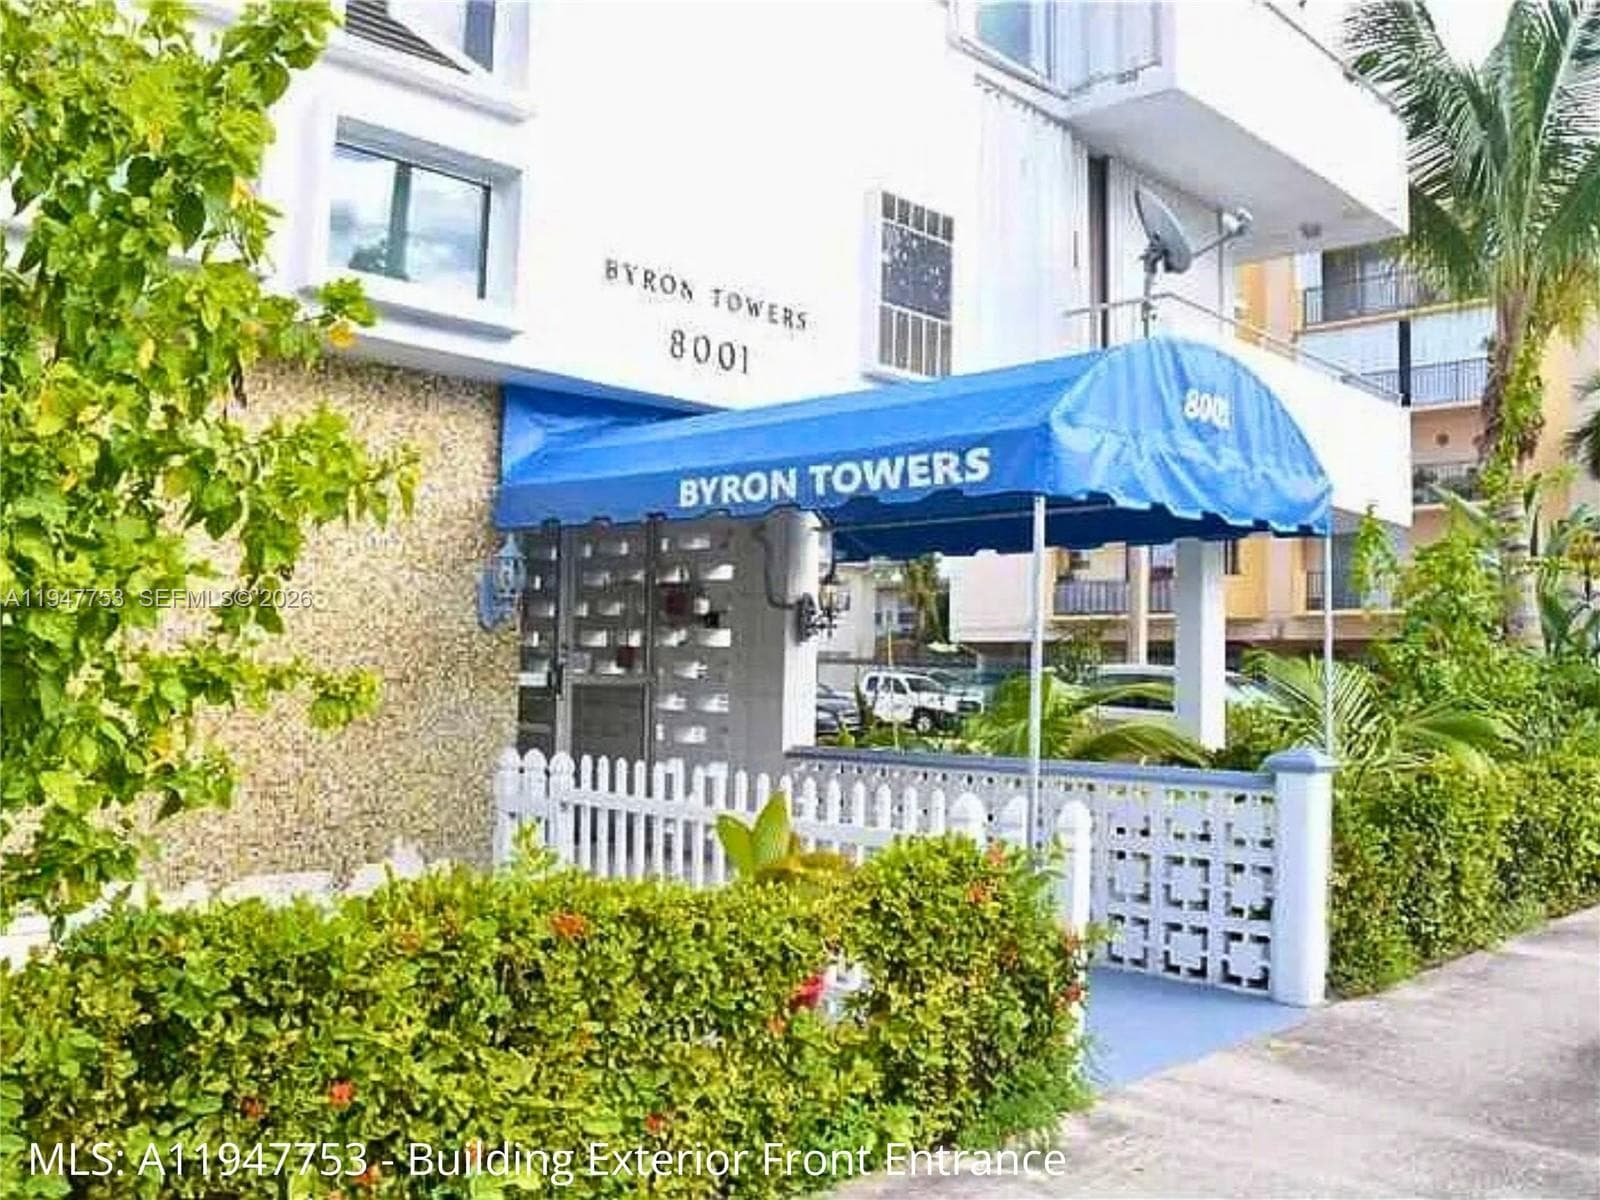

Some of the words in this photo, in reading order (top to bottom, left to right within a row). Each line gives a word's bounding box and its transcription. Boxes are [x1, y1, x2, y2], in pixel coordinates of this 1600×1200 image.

[605, 257, 694, 300] BYRON
[711, 287, 809, 330] TOWERS
[669, 329, 749, 375] 8001
[679, 467, 798, 507] BYRON
[809, 447, 991, 495] TOWERS
